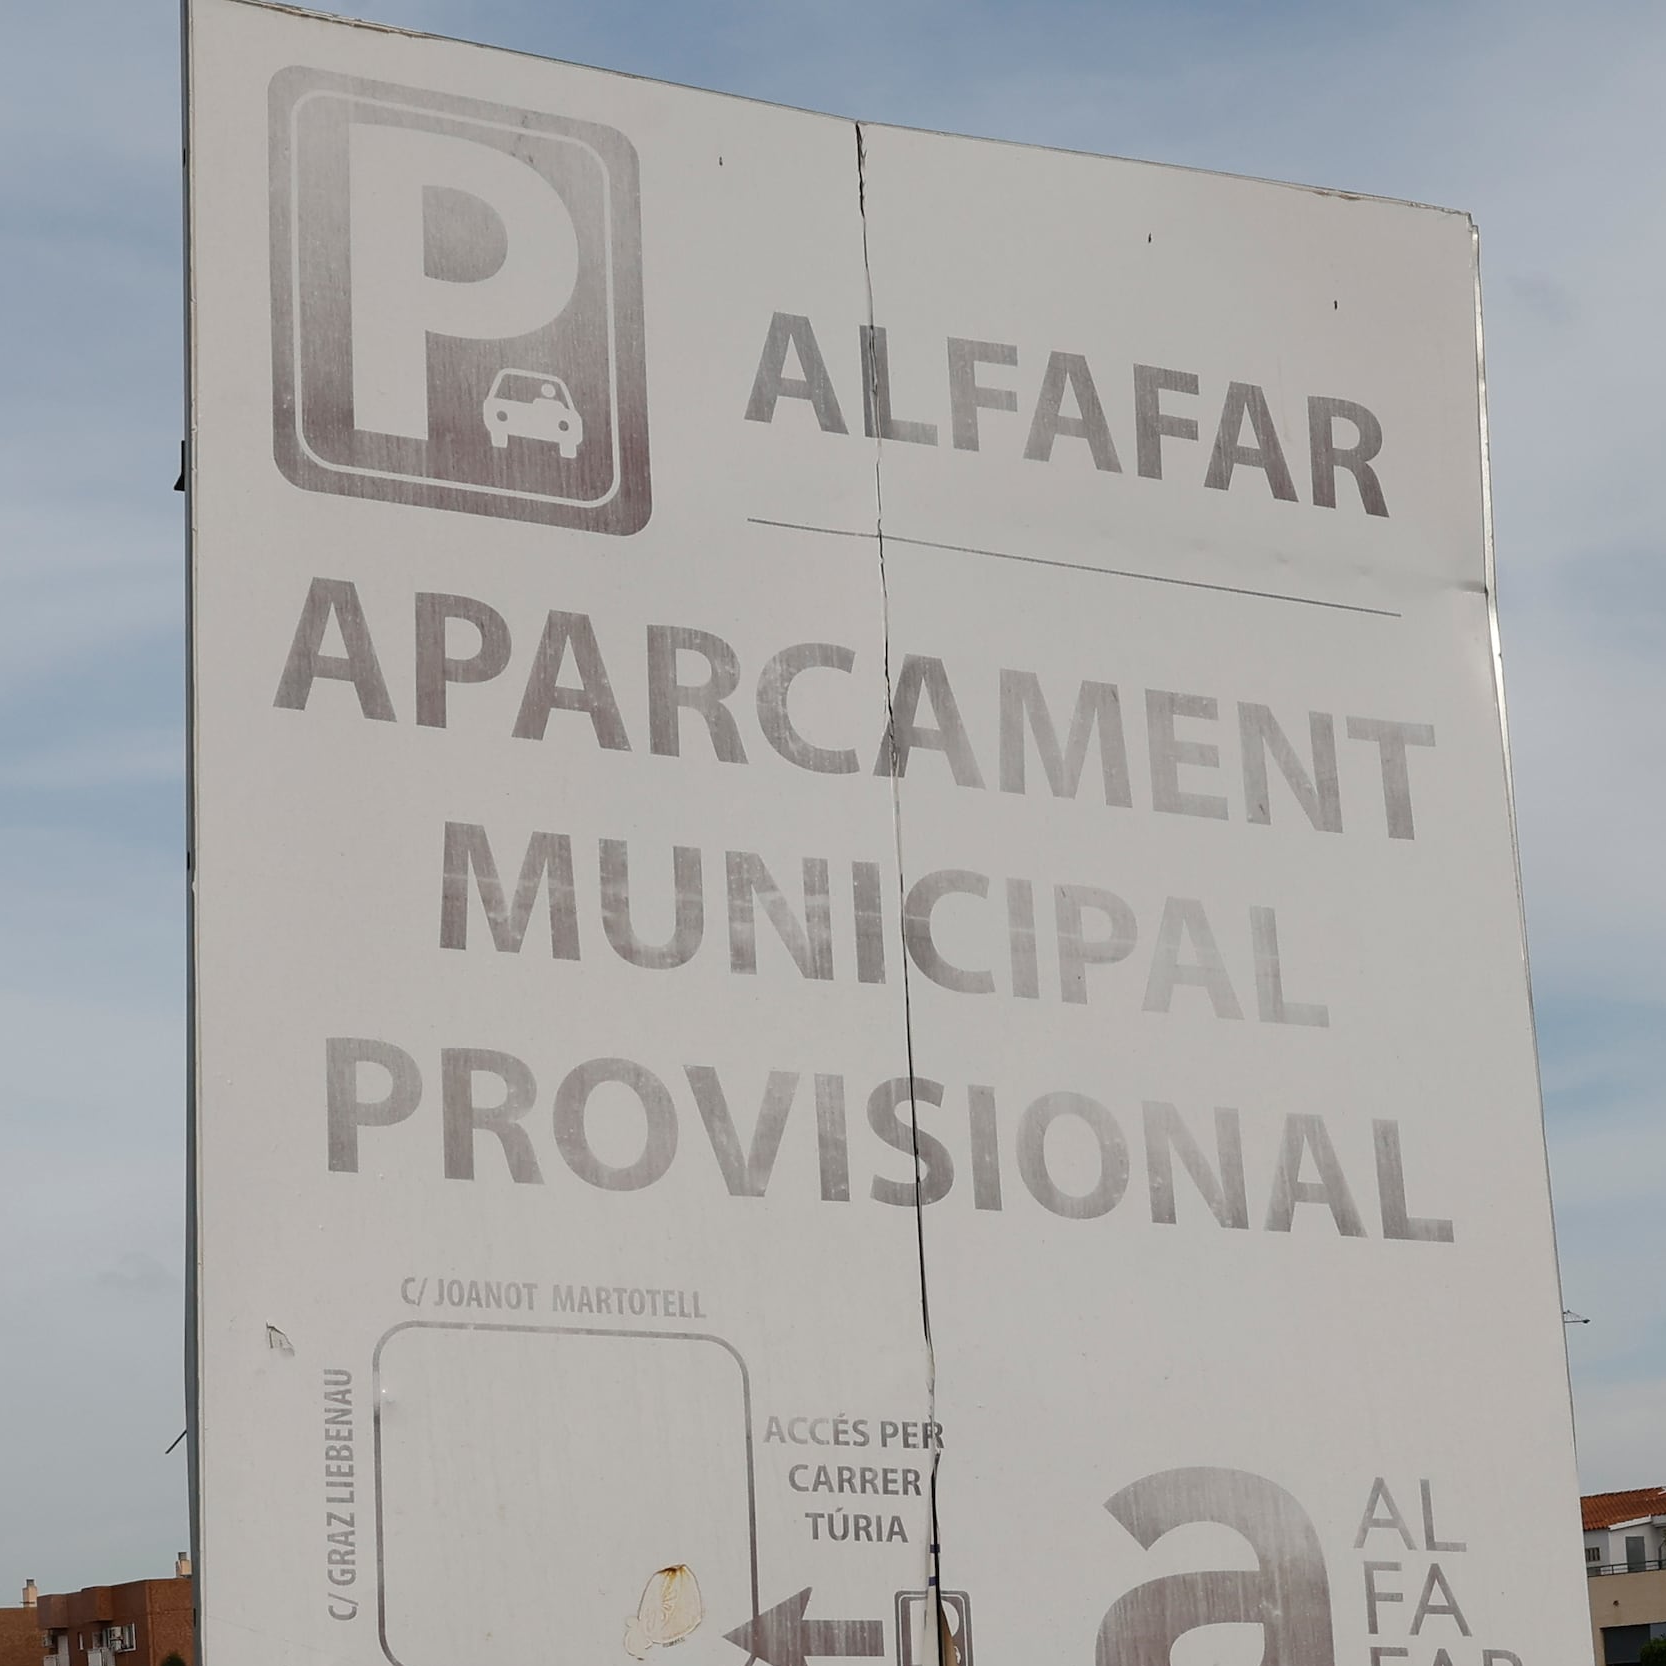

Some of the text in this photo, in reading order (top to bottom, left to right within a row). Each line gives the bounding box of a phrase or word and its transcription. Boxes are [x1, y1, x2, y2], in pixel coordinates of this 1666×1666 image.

[349, 123, 580, 441] P
[744, 310, 1390, 519] ALFAFAR
[273, 577, 1436, 840] APARCAMENT
[438, 820, 1331, 1028] MUNICIPAL
[326, 1037, 1454, 1243] PROVISIONAL
[401, 1277, 707, 1319] C/ JOANOT MARTOTELL
[323, 1368, 360, 1621] C/ GRAZ LIEBENAU
[763, 1411, 945, 1450] ACCÉS PER
[788, 1463, 922, 1497] CARRER
[805, 1506, 910, 1544] TÚRIA
[1353, 1476, 1467, 1553] AL
[1363, 1560, 1472, 1637] FA
